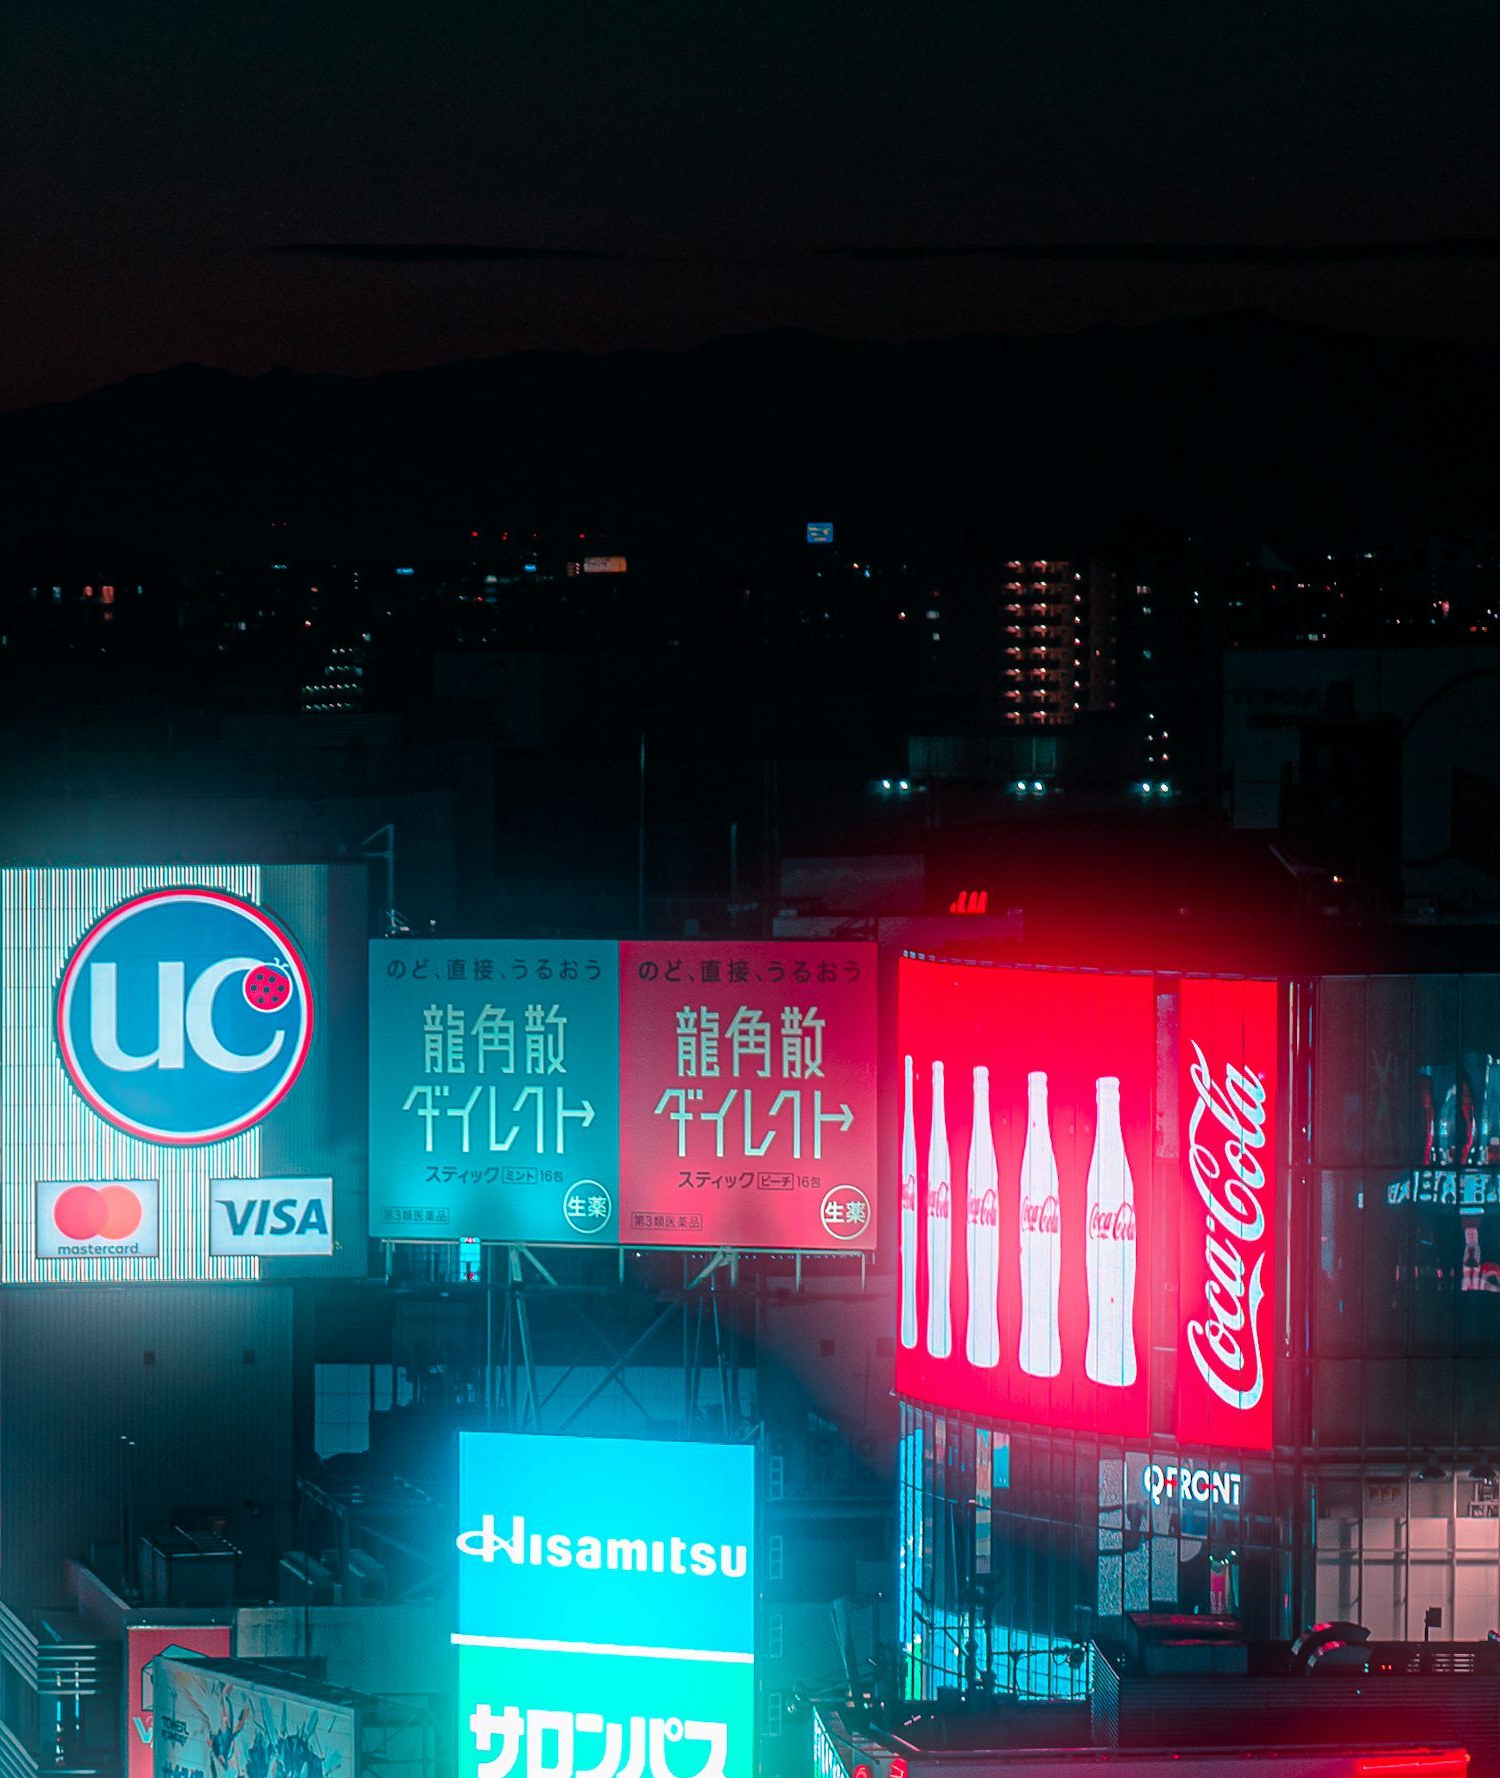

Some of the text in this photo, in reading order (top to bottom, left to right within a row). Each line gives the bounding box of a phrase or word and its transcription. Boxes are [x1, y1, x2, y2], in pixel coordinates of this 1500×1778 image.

[386, 956, 605, 983] のど、直接、うるおう
[638, 958, 863, 986] のど、直接、うるおう
[422, 1003, 567, 1076] 龍角散
[675, 1004, 827, 1080] 龍角散
[403, 1085, 595, 1155] ダイレクト
[654, 1087, 854, 1160] ダイレクト
[425, 1166, 564, 1183] スティック ミント 16包
[678, 1171, 822, 1189] スティック ピーチ 16包
[216, 1198, 329, 1236] VISA
[567, 1195, 608, 1217] 生薬
[631, 1213, 701, 1230] 第3類医薬品
[824, 1200, 866, 1223] 生薬
[1187, 1039, 1267, 1410] Coca-Cola
[455, 1514, 747, 1578] Hisamitsu
